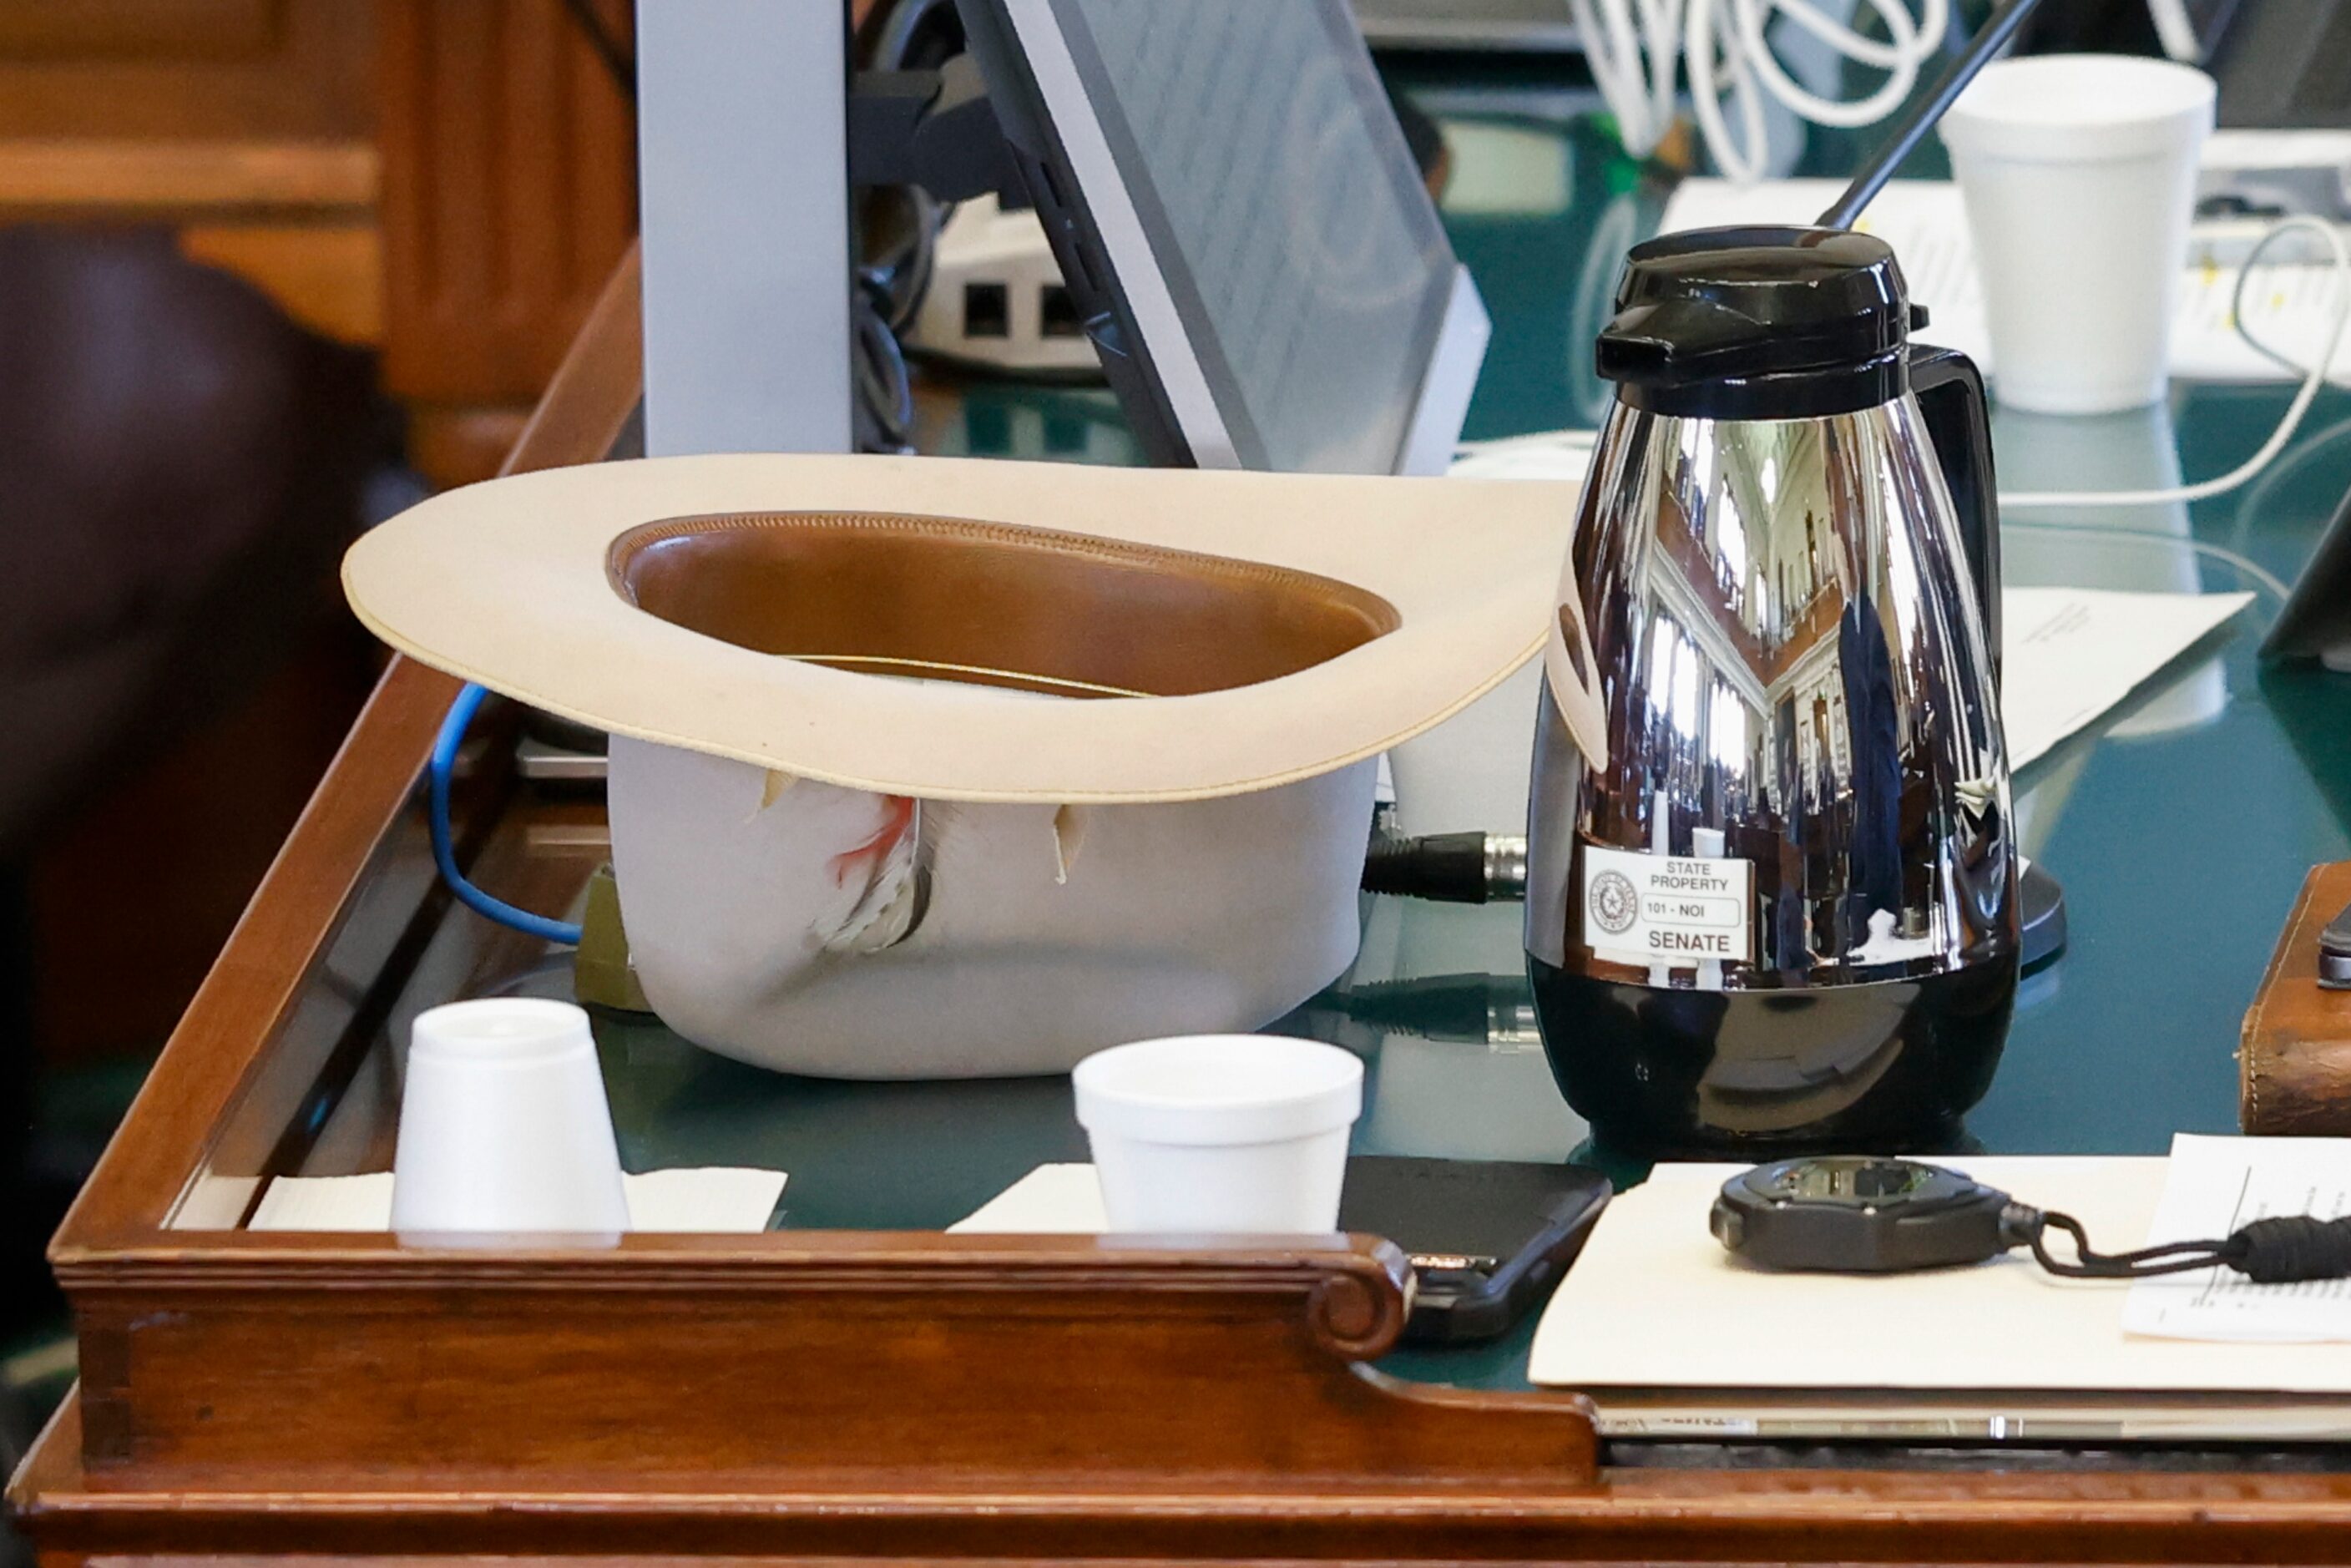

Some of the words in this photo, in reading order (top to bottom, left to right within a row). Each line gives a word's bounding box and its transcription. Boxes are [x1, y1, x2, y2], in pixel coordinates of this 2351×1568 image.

[1667, 862, 1711, 875] STATE
[1651, 875, 1729, 891] PROPERTY
[1648, 903, 1666, 913] 101
[1650, 931, 1731, 952] SENATE
